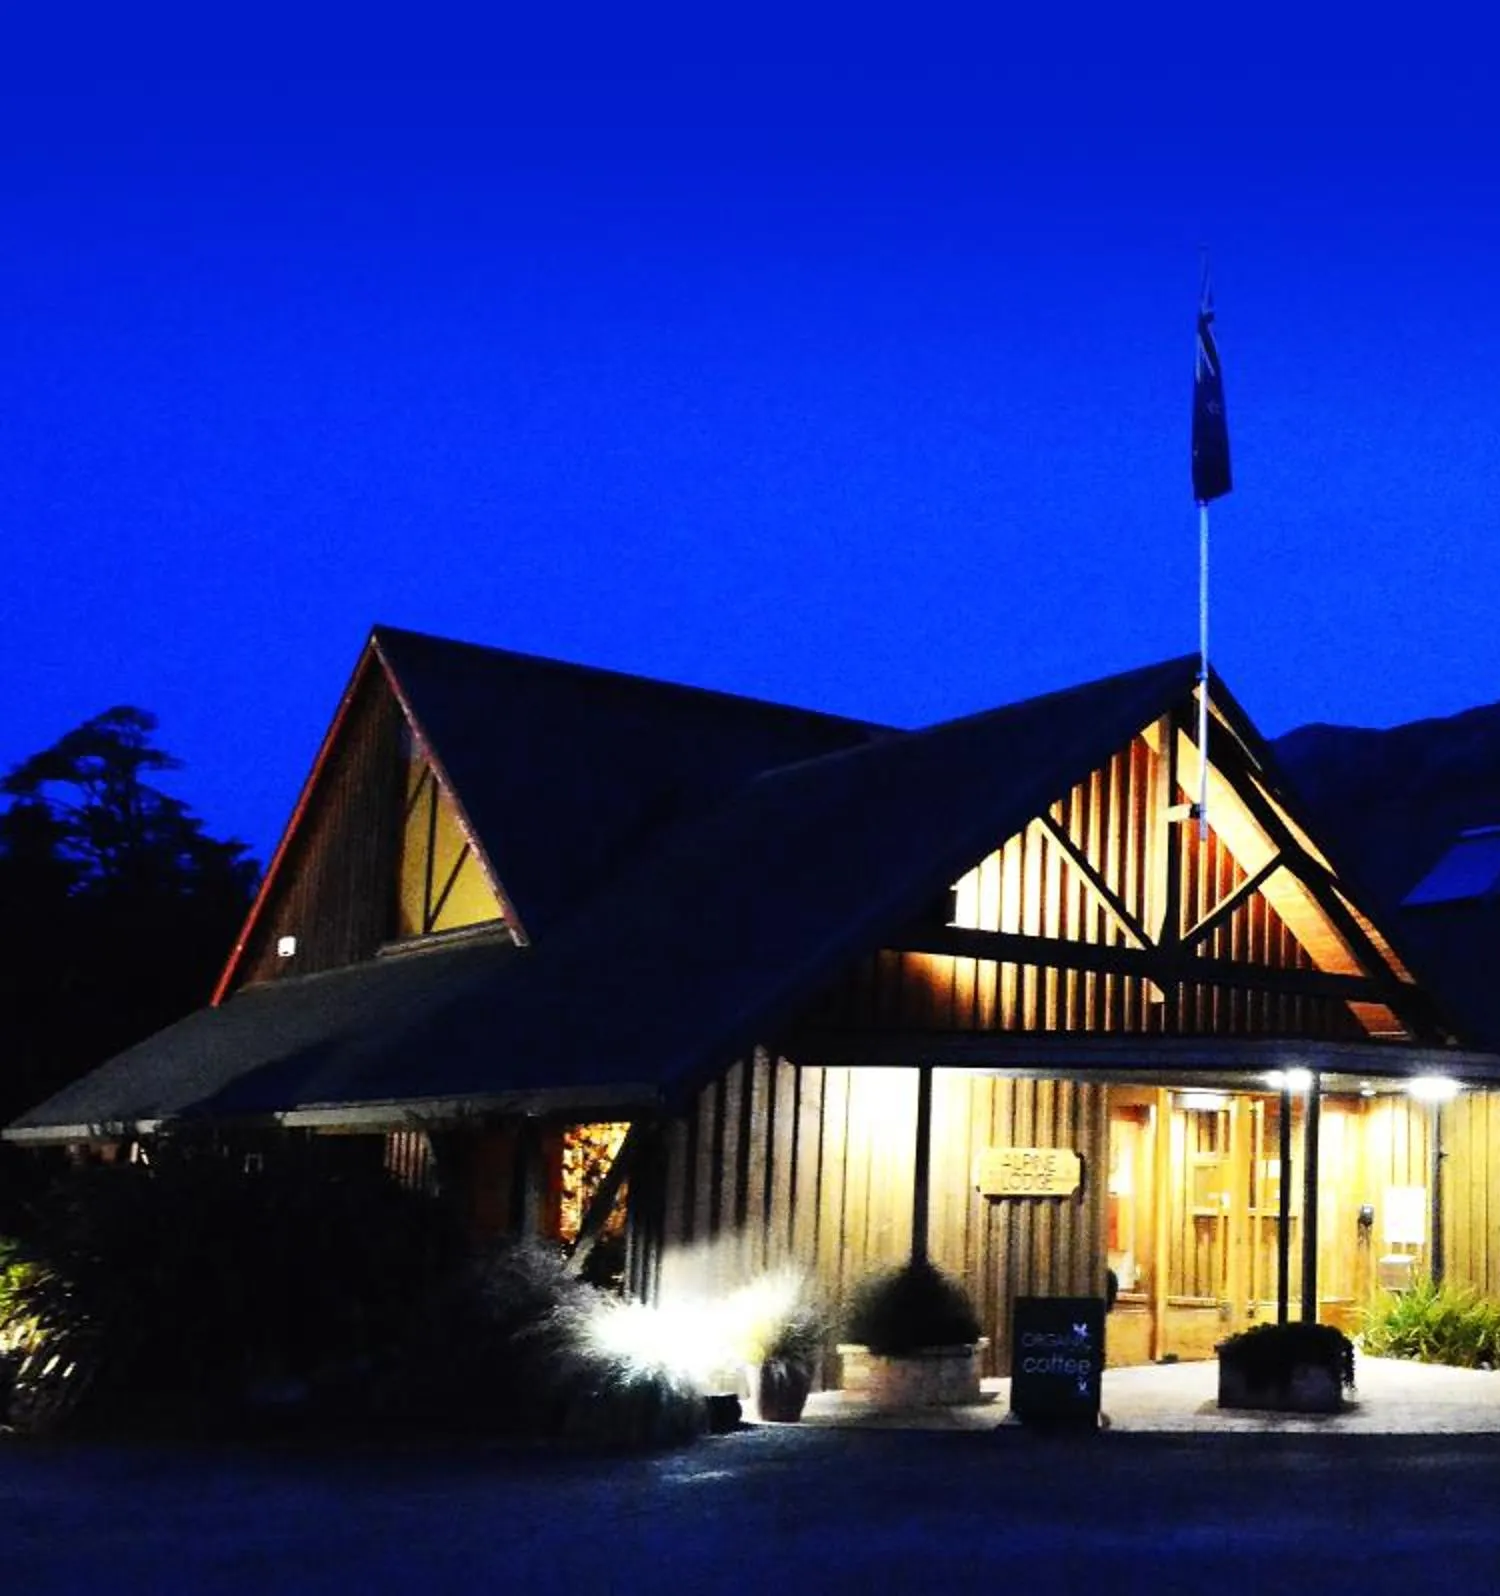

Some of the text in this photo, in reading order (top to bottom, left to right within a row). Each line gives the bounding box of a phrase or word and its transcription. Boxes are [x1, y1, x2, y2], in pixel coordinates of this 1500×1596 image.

[1001, 1153, 1057, 1172] ALPINE
[1001, 1172, 1054, 1190] LODGE
[1023, 1353, 1091, 1374] coffee
